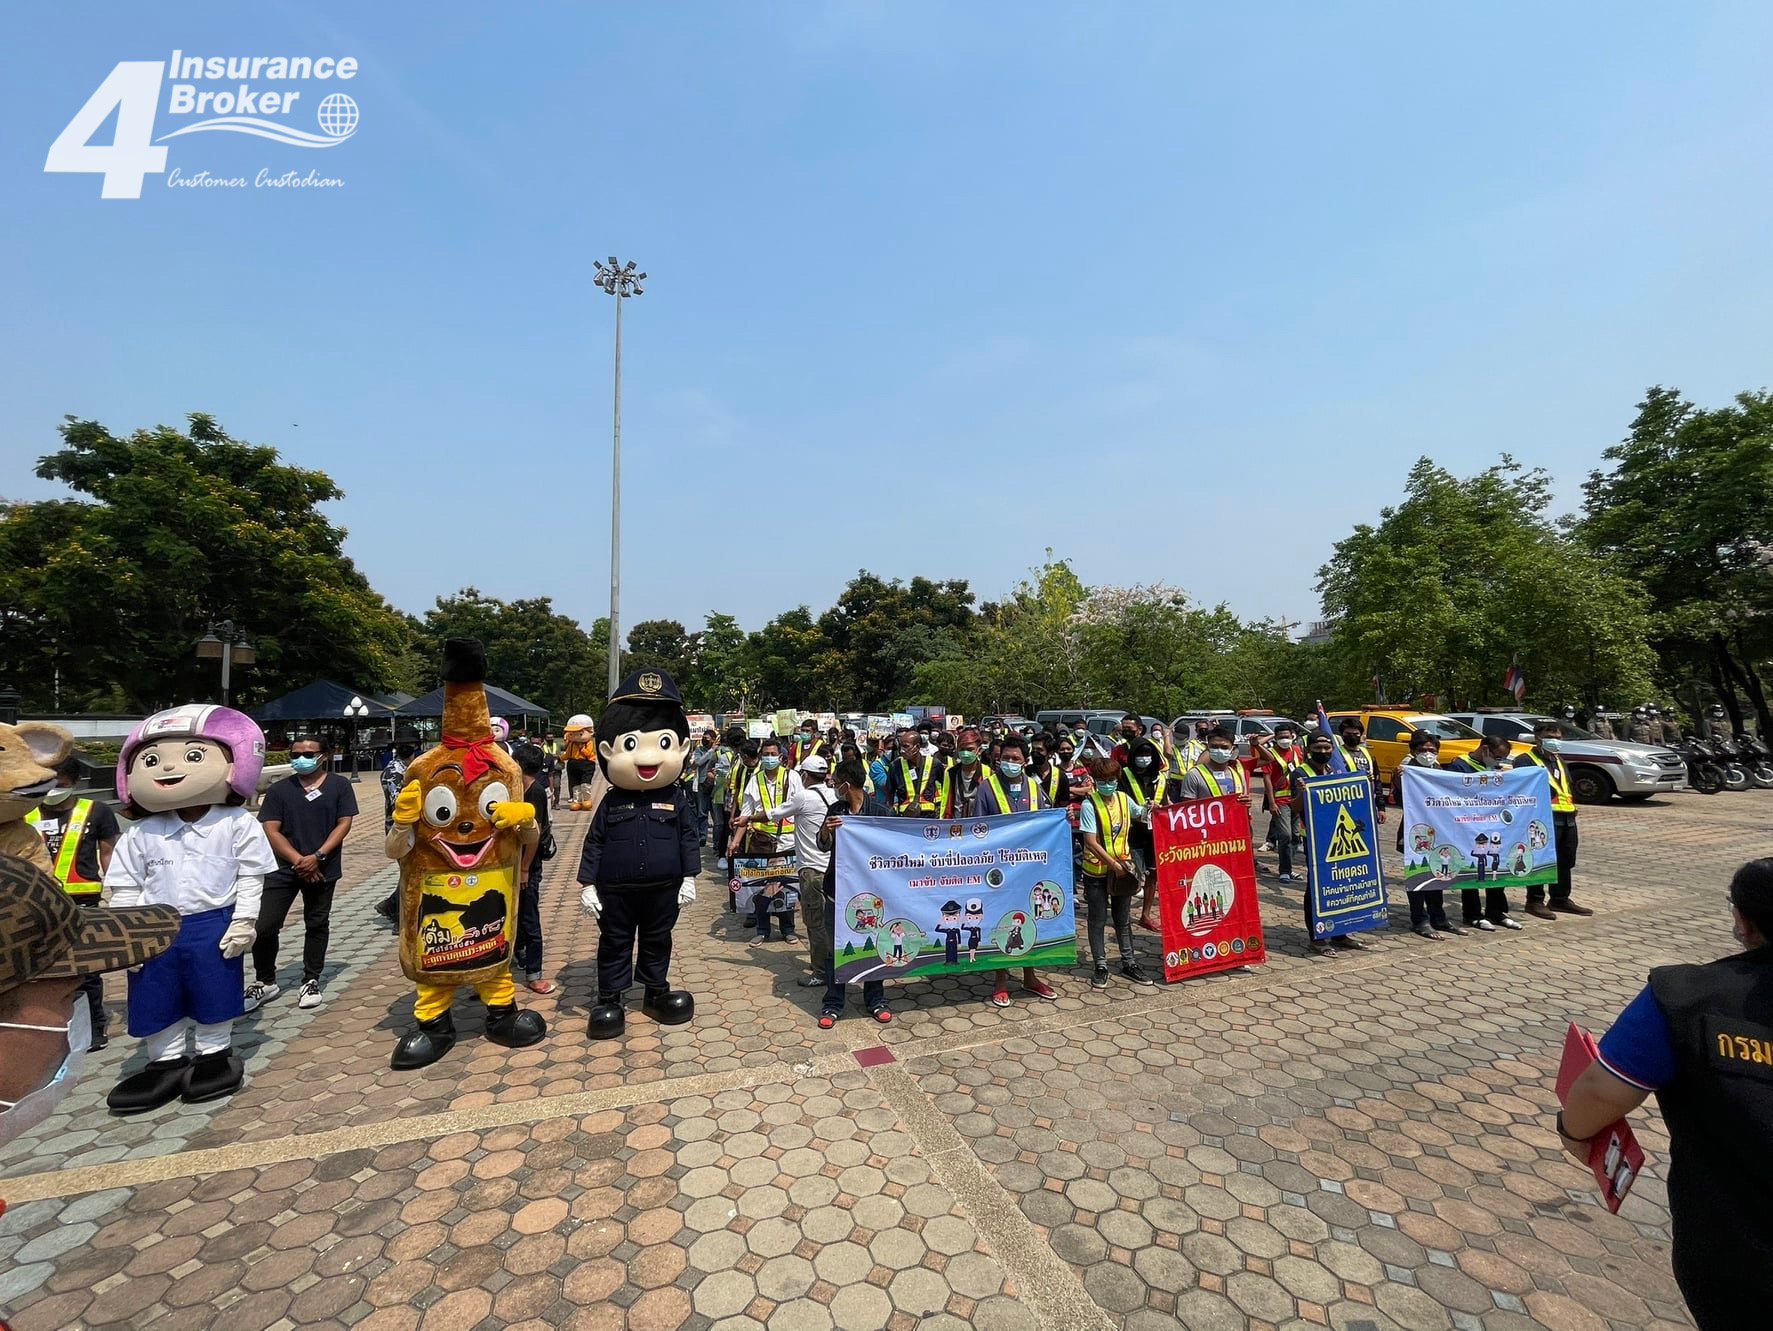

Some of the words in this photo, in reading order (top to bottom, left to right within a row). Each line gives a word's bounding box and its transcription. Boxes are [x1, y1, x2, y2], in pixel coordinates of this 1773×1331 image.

[1316, 784, 1364, 808] ขอบคุณ
[1168, 801, 1225, 839] หยุด
[869, 854, 925, 870] ชีวิตวิถีใหม่
[930, 848, 994, 867] ขับขี่ปลอดภัย
[998, 847, 1047, 866] ไร้อุบัติเหตุ
[1158, 839, 1246, 866] ระวังคนข้ามถนน
[909, 876, 936, 887] เมาขับ
[1331, 862, 1369, 883] ที่หยุดรถ
[1322, 879, 1377, 897] ให้คนข้ามทางม้าลาย
[425, 921, 451, 944] ดื่ม
[1717, 1033, 1773, 1066] กรม
